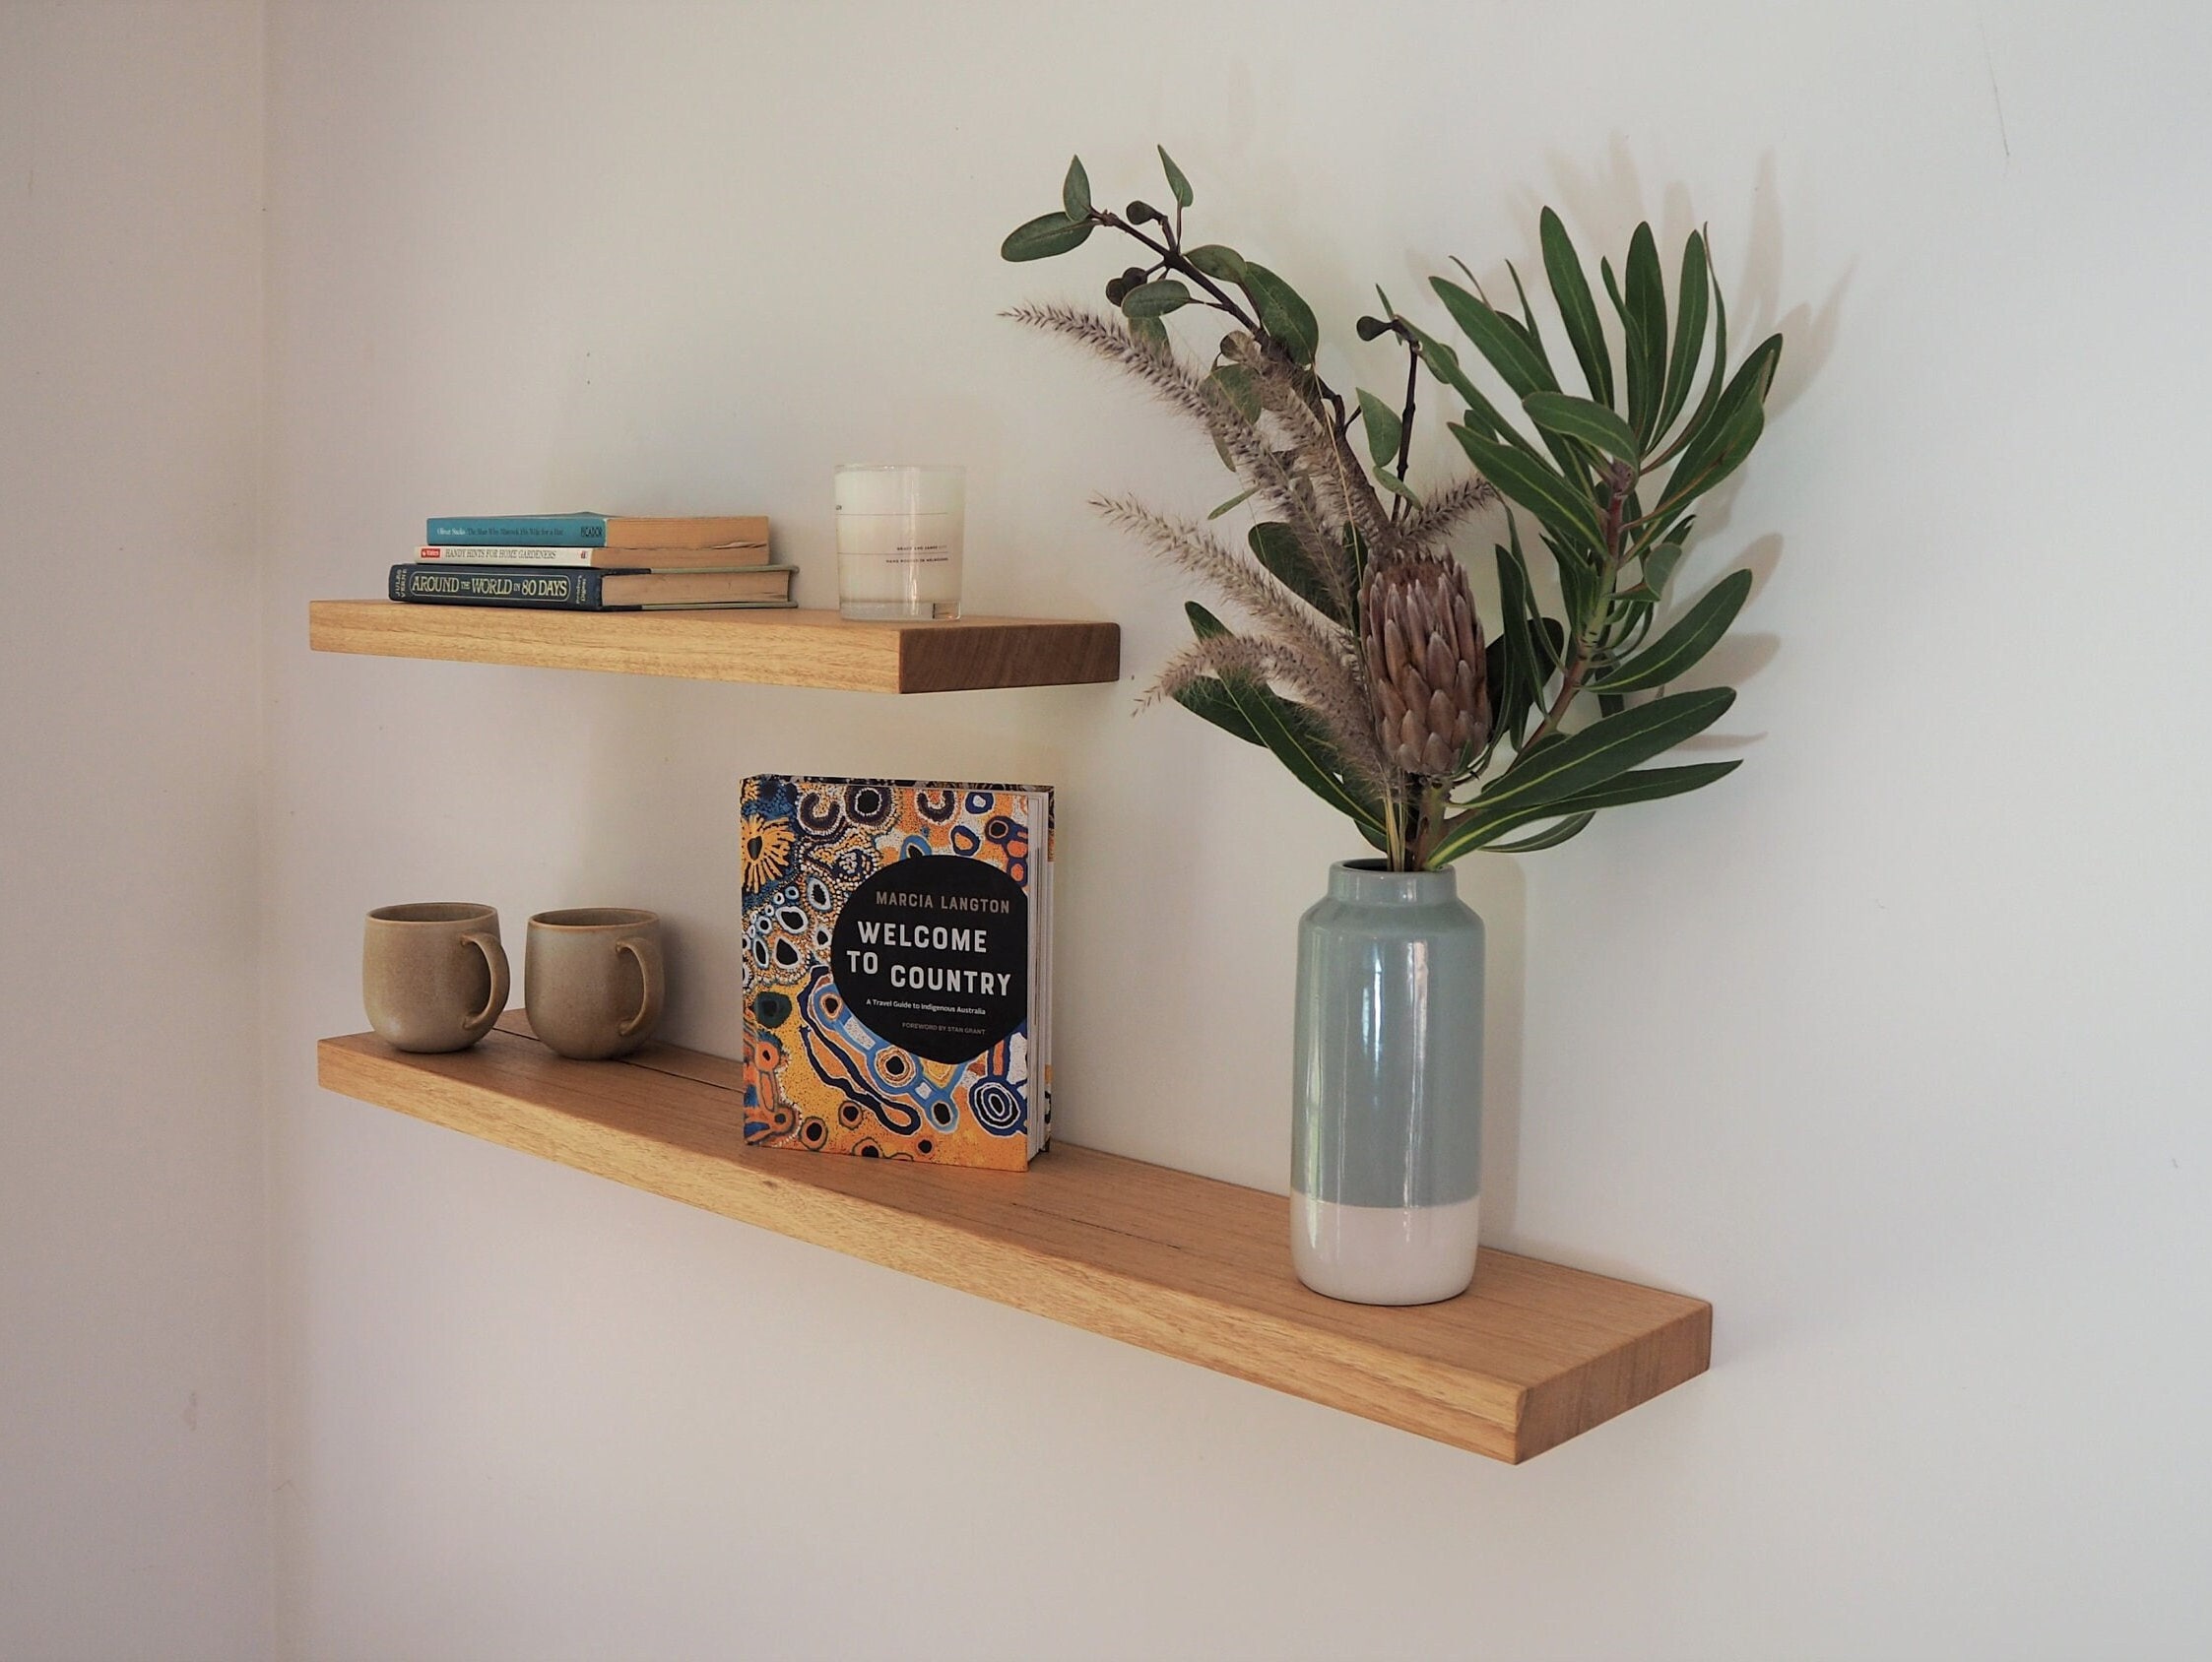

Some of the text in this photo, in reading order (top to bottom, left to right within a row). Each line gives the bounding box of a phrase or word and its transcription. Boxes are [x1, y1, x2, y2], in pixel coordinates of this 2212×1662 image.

[445, 548, 556, 559] HANDY HINTS FOR HOME GARDENERS
[413, 575, 459, 593] AROUND
[461, 581, 471, 590] THE
[472, 578, 512, 595] WORLD
[521, 579, 537, 596] 80
[538, 579, 567, 597] DAYS
[876, 891, 1009, 914] MARCIA LANGTON
[857, 921, 987, 953] WELCOME
[846, 950, 1011, 996] TO COUNTRY
[873, 998, 892, 1007] Travel
[893, 1000, 911, 1009] Guide
[921, 1003, 955, 1012] Indigenous
[956, 1006, 986, 1015] Australia
[902, 1022, 938, 1031] FOREWORD
